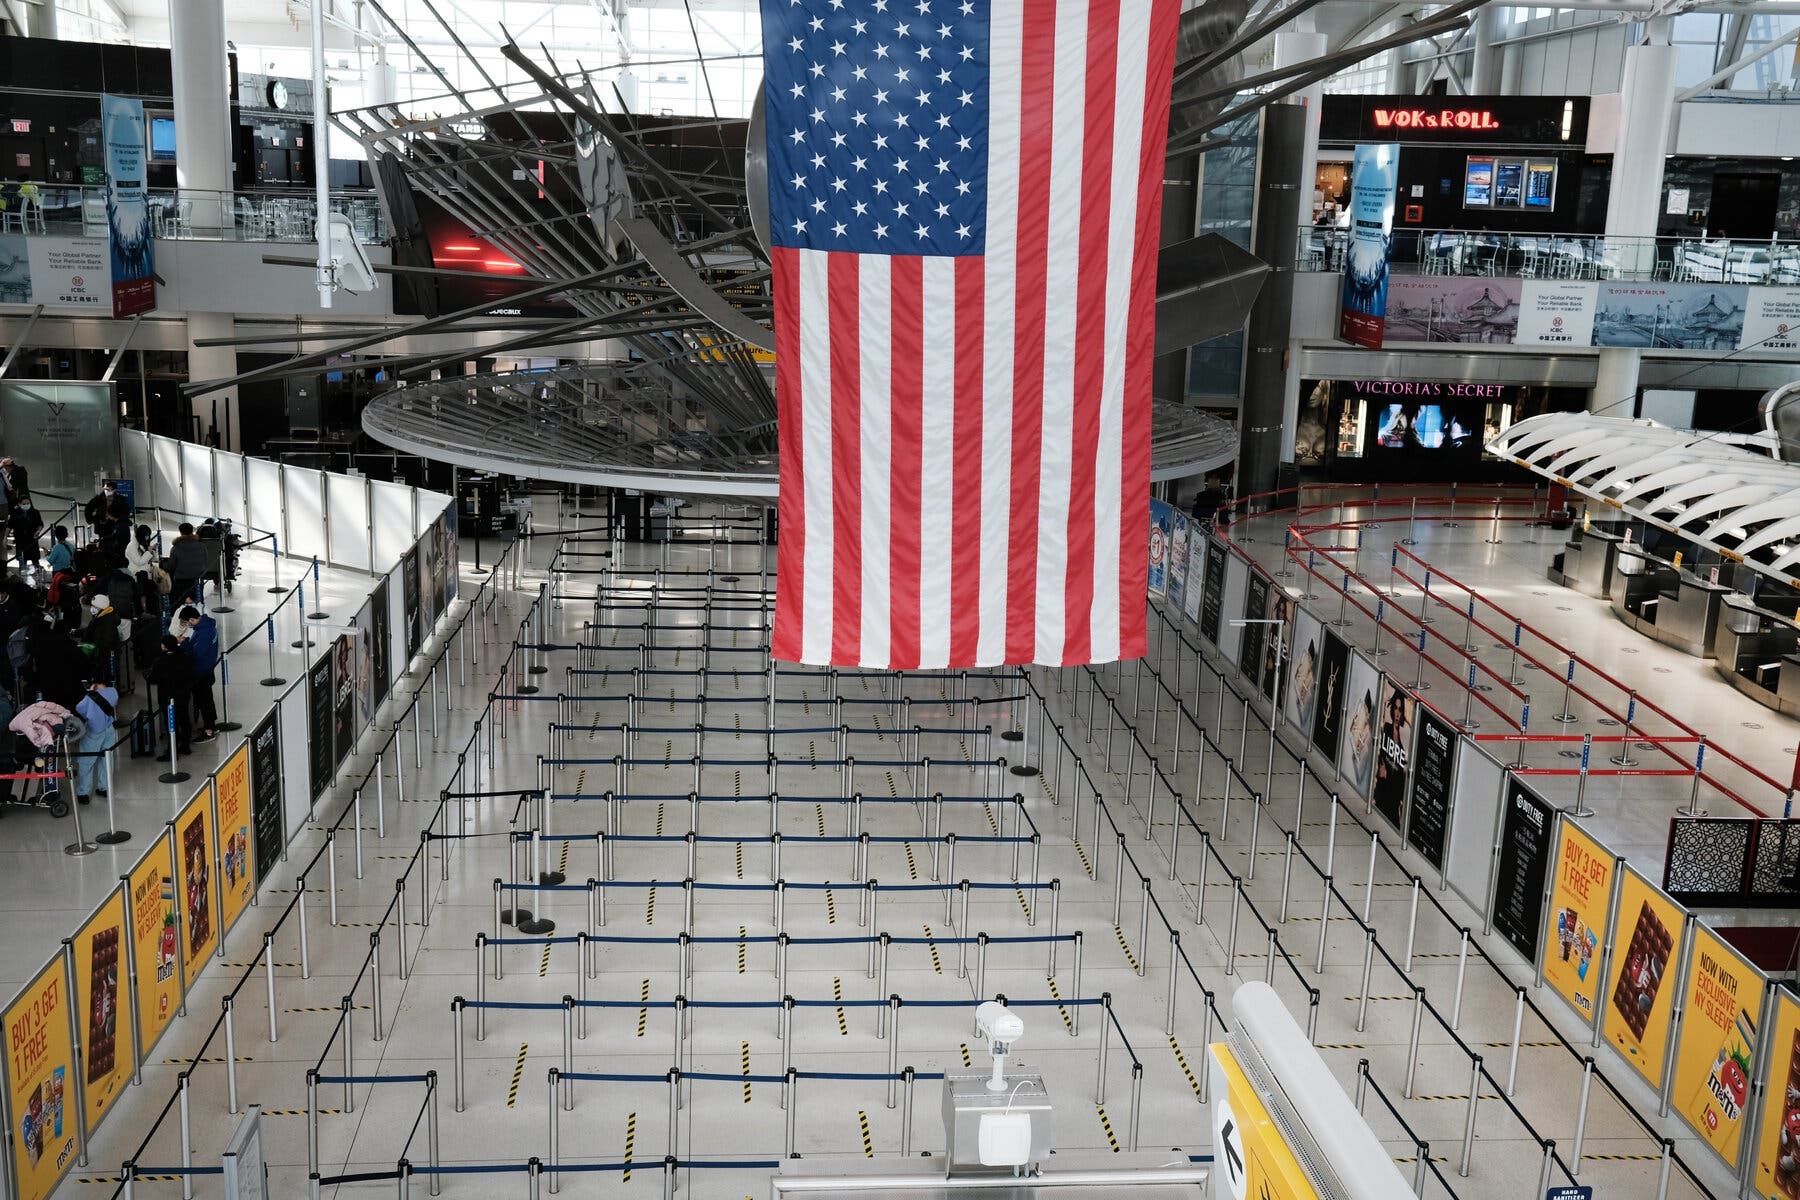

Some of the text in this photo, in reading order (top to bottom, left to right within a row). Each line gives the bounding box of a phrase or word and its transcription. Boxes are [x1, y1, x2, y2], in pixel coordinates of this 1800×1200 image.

[1354, 380, 1504, 397] VICTORIA'S SECRET
[1382, 732, 1406, 769] LIBRE
[219, 780, 230, 803] BUY
[226, 791, 239, 822] FREE
[1522, 798, 1533, 816] DUTY
[1533, 806, 1544, 826] FREE
[1563, 861, 1568, 881] 1
[1569, 866, 1593, 900] FREE
[1566, 838, 1584, 867] BUY
[1583, 853, 1590, 874] 3
[1590, 858, 1608, 888] GET
[135, 880, 146, 905] NOW
[136, 883, 160, 924] EXCLUSIVE
[1700, 951, 1738, 994] NOW WITH
[1694, 992, 1707, 1012] NY
[1697, 971, 1737, 1018] EXCLUSIVE
[12, 978, 60, 1052] BUY 3 GET
[14, 1022, 48, 1081] 1 FREE
